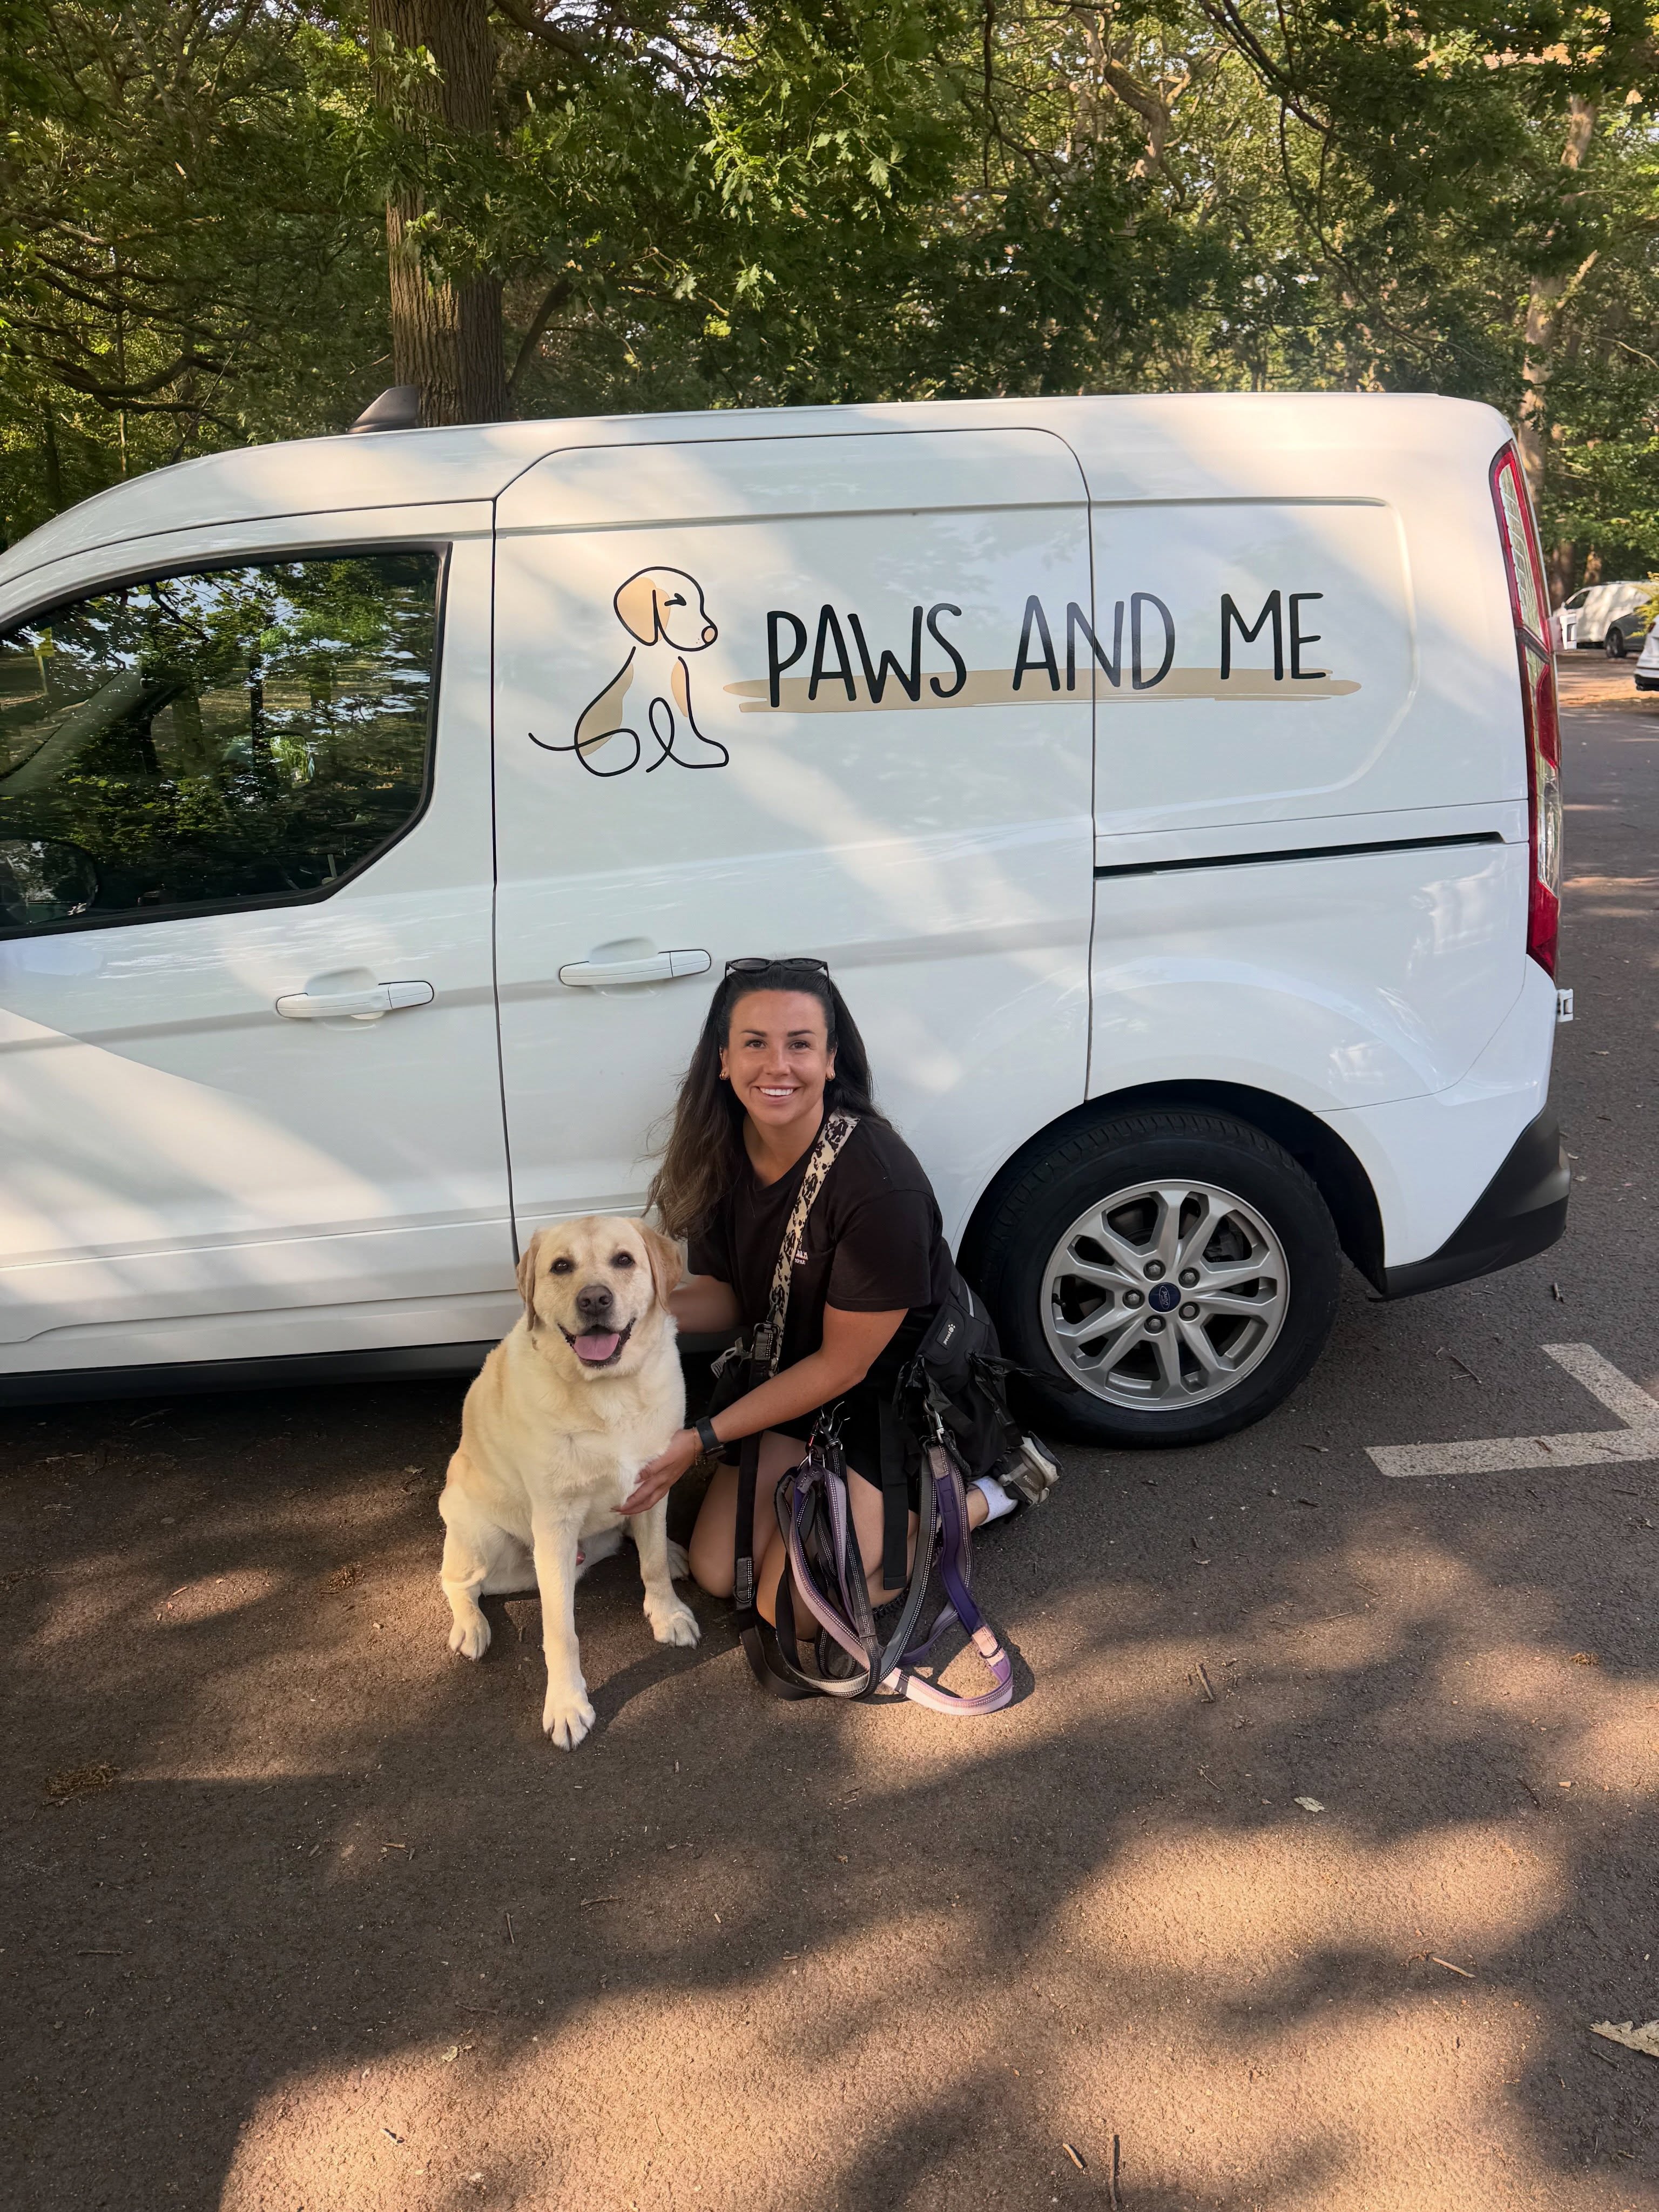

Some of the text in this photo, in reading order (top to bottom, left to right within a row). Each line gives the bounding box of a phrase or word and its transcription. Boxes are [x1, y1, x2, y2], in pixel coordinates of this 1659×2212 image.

[767, 589, 1326, 708] PAWS AND ME
[1161, 1291, 1169, 1305] Ford
